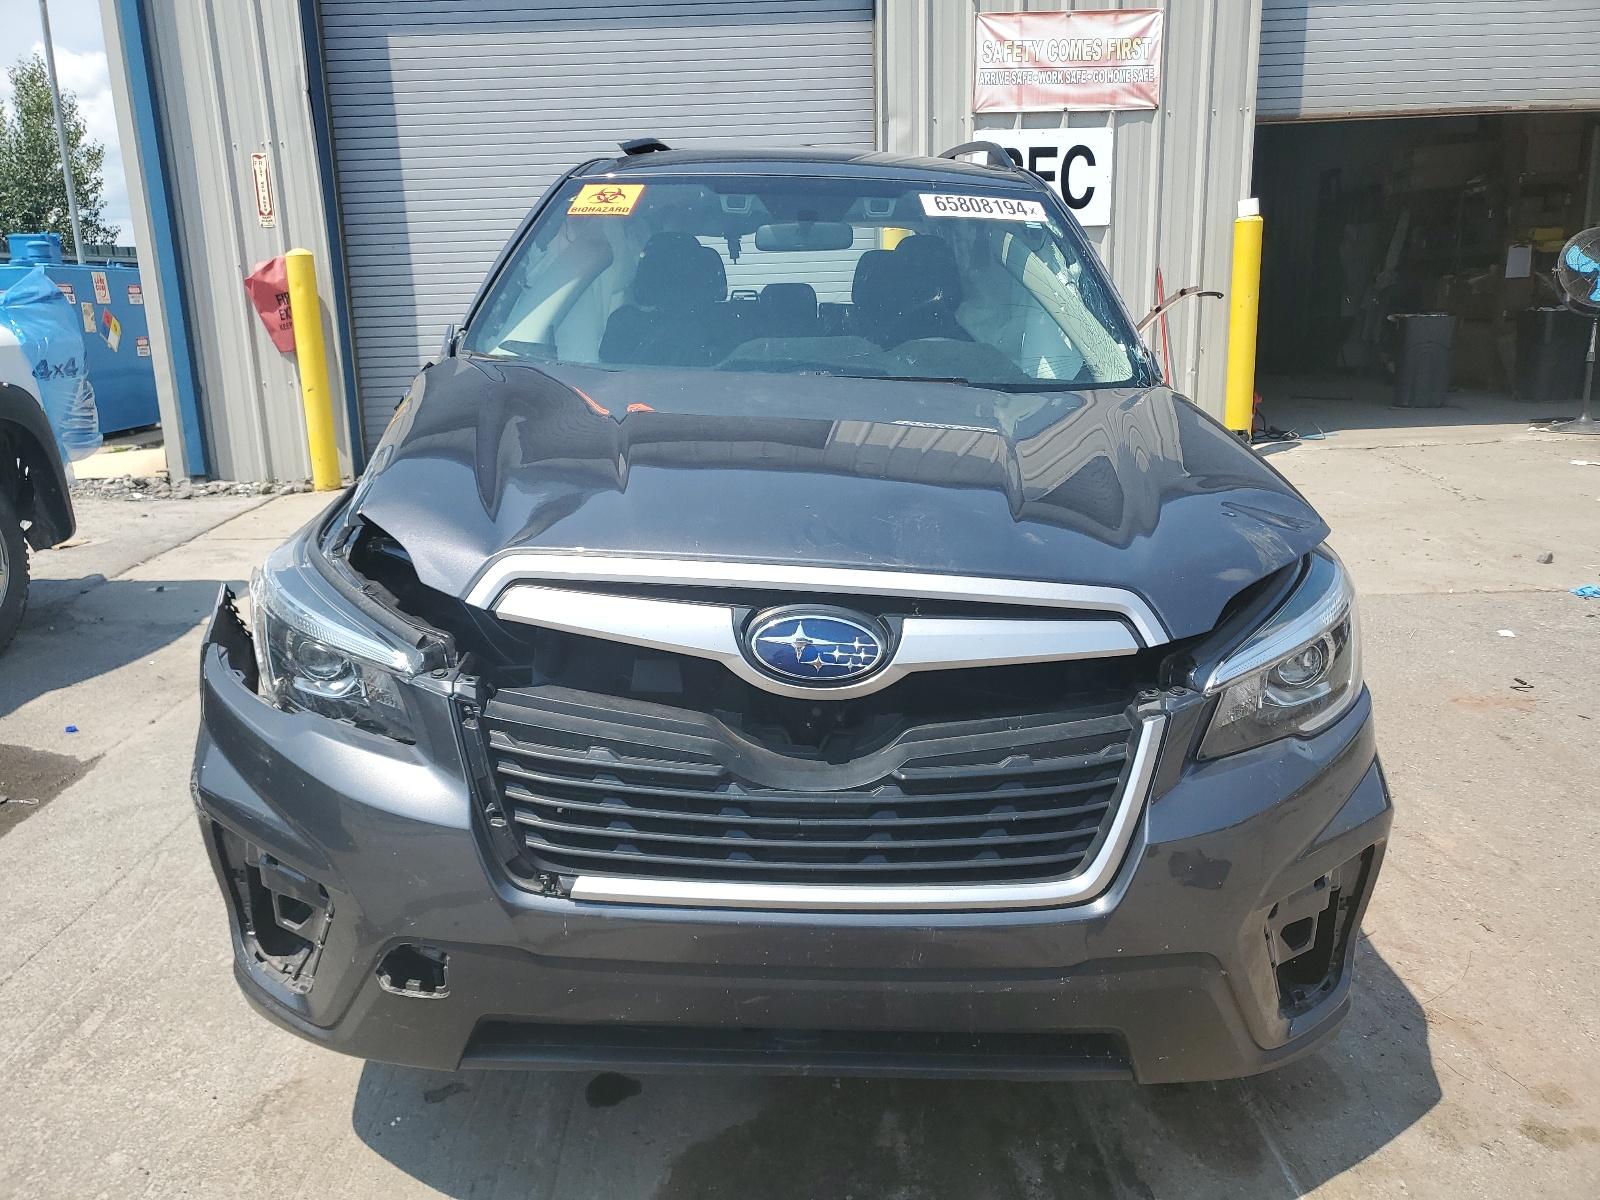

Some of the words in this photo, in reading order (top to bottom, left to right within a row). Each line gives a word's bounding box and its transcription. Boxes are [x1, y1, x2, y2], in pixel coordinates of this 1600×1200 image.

[982, 39, 1044, 63] SAFETY
[1047, 37, 1103, 63] COMES
[1106, 37, 1151, 60] FIRST
[978, 70, 1010, 86] ARRIVE
[1010, 70, 1034, 86] SAFE
[1038, 69, 1064, 85] WORK
[1065, 69, 1088, 85] SAFE
[1092, 68, 1106, 83] GO
[1106, 67, 1132, 83] HOME
[1132, 67, 1155, 83] SAFE
